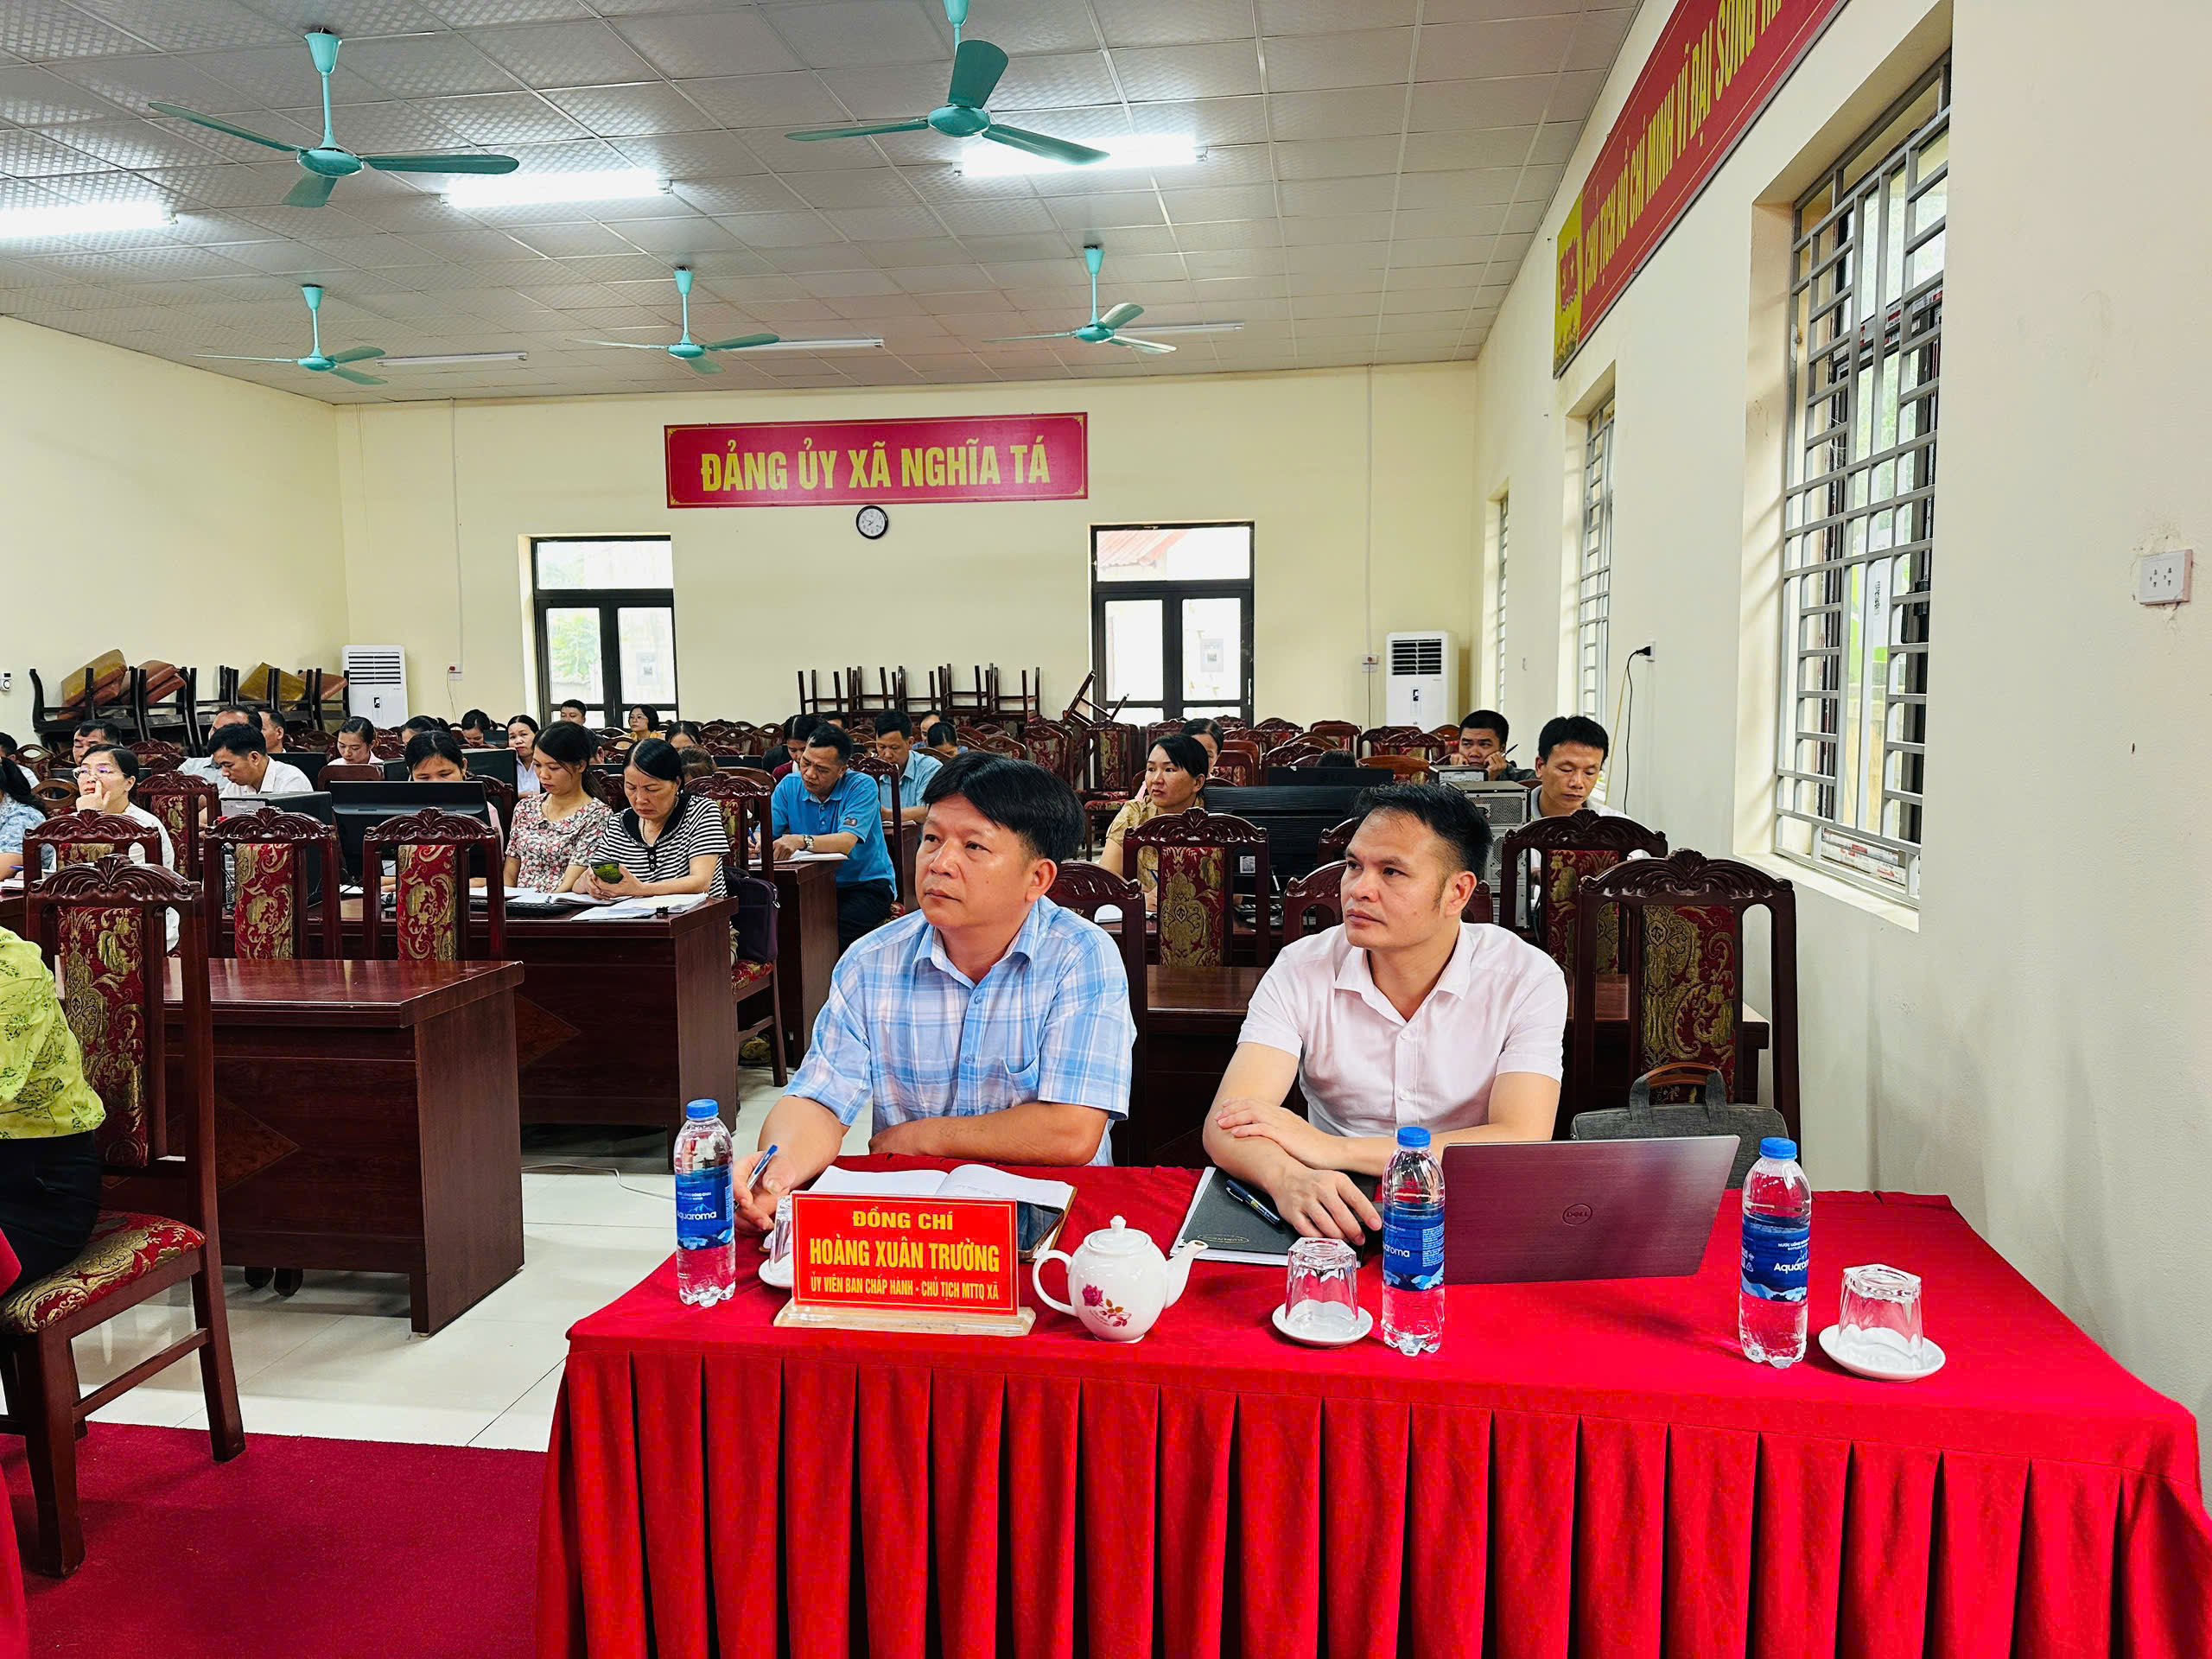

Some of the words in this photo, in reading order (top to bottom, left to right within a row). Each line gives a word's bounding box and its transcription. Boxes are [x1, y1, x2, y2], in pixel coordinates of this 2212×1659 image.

[1599, 182, 1616, 286] TỊCH
[1616, 135, 1630, 249] HỒ
[1630, 114, 1646, 228] CHÍ
[1646, 82, 1675, 205] MINH
[1690, 17, 1713, 148] ĐẠI
[701, 439, 788, 492] ĐẢNG
[798, 437, 837, 489] ỦY
[849, 441, 892, 488] XÃ
[901, 437, 1001, 487] NGHĨA
[1010, 435, 1051, 485] TÁ
[852, 1205, 911, 1229] ĐỒNG
[918, 1211, 953, 1230] CHÍ
[810, 1233, 870, 1267] HOÀNG
[875, 1236, 924, 1269] XUÂN
[928, 1238, 1000, 1273] TRƯỜNG
[810, 1271, 822, 1293] ỦY
[823, 1274, 843, 1293] VIÊN
[845, 1277, 863, 1294] BAN
[865, 1273, 887, 1294] CHẤP
[889, 1276, 913, 1296] HÀNH
[921, 1276, 939, 1297] CHỦ
[940, 1281, 960, 1300] TỊCH
[962, 1283, 985, 1300] MTTQ
[987, 1281, 999, 1300] XÃ
